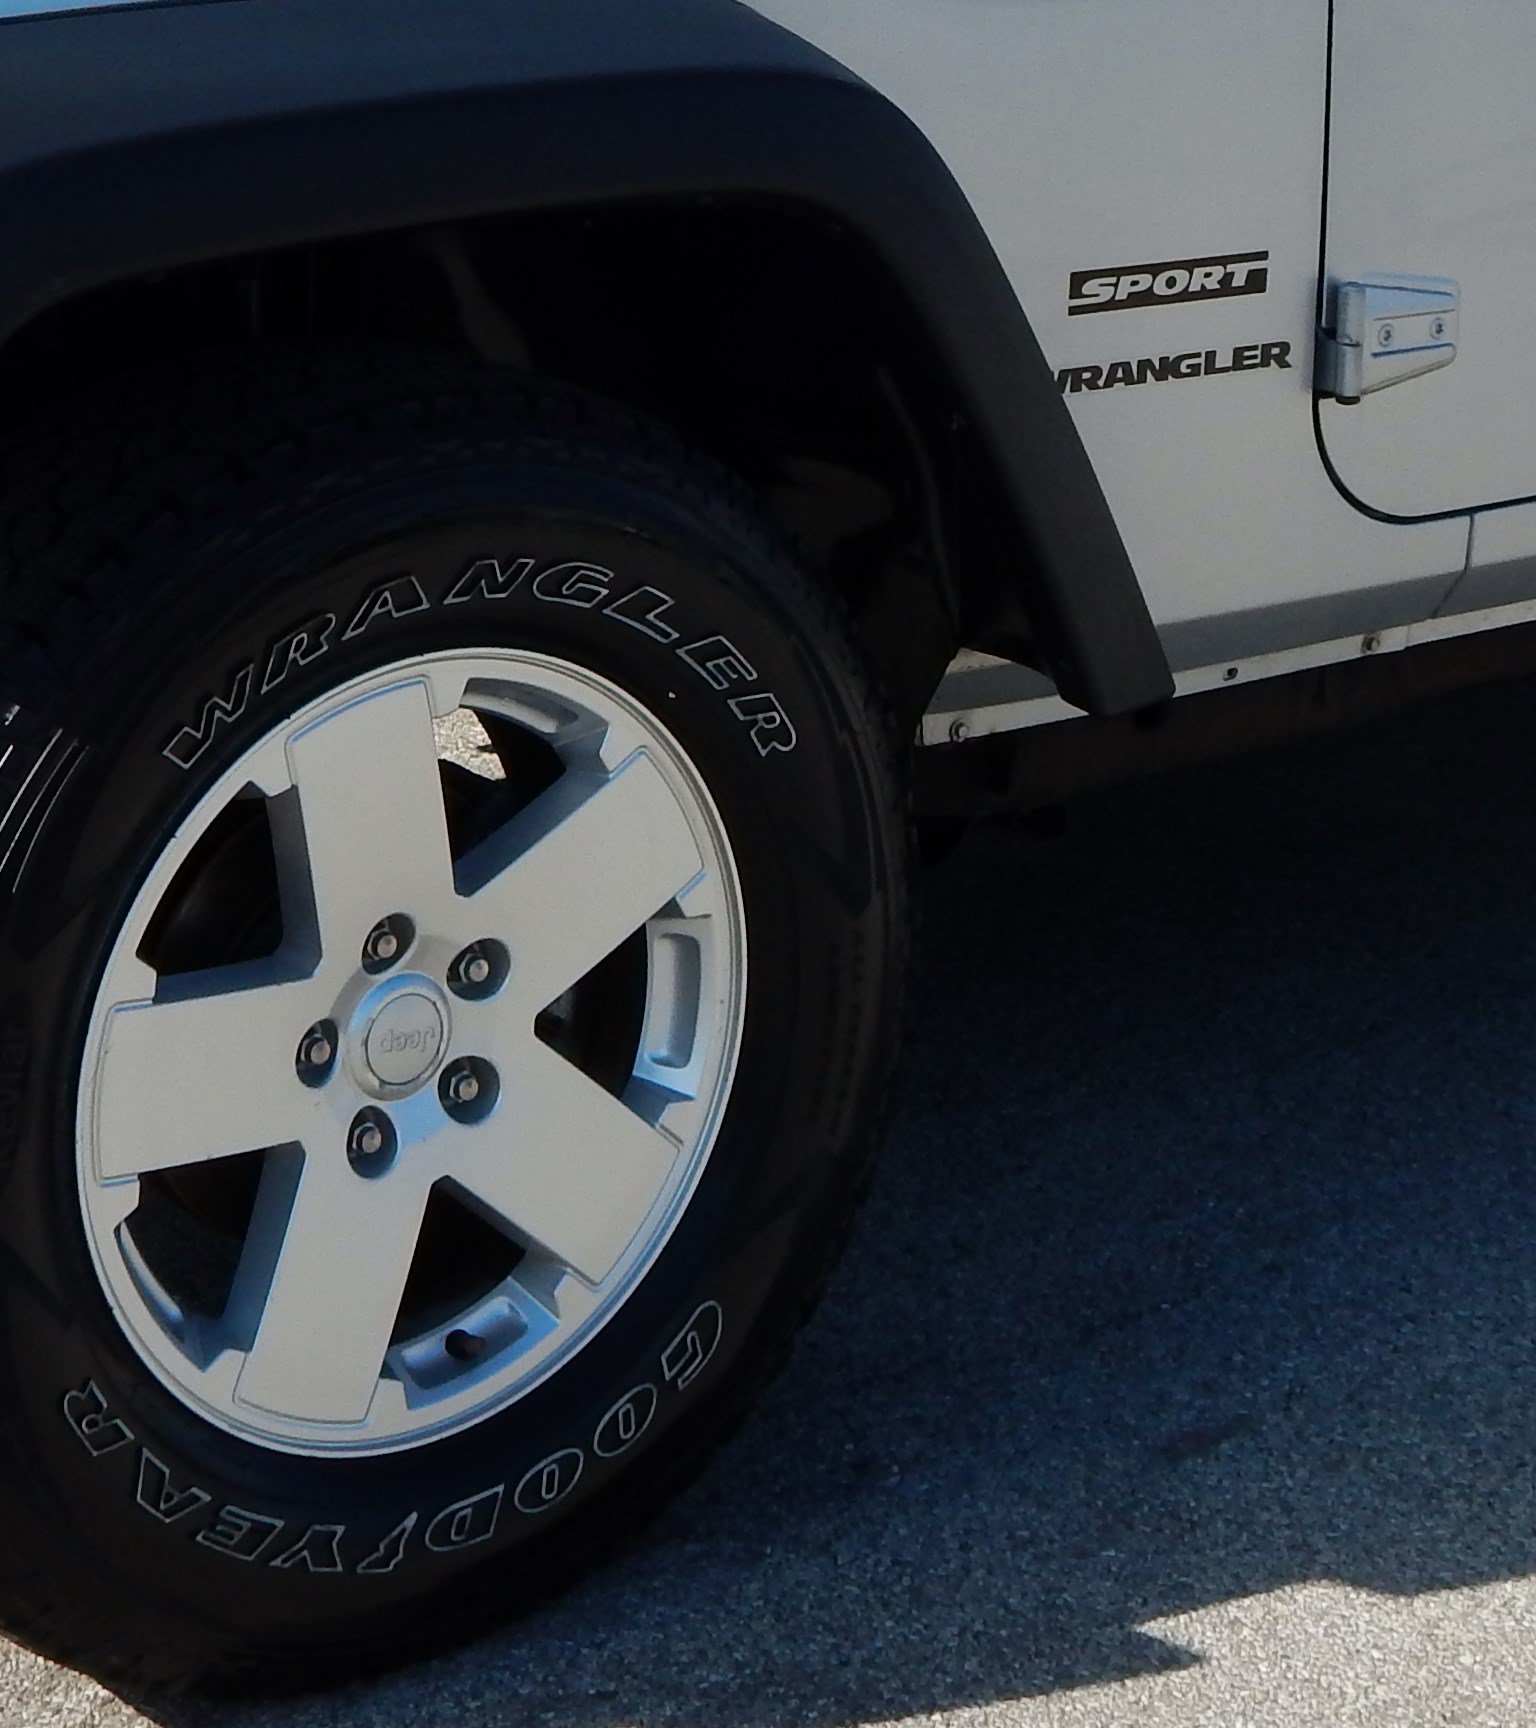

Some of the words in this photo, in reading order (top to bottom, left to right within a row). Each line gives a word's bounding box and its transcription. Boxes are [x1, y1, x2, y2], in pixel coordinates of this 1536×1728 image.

[1068, 258, 1269, 306] SPORT
[162, 557, 797, 769] WRANGLER
[63, 1299, 723, 1573] GOODYEAR
